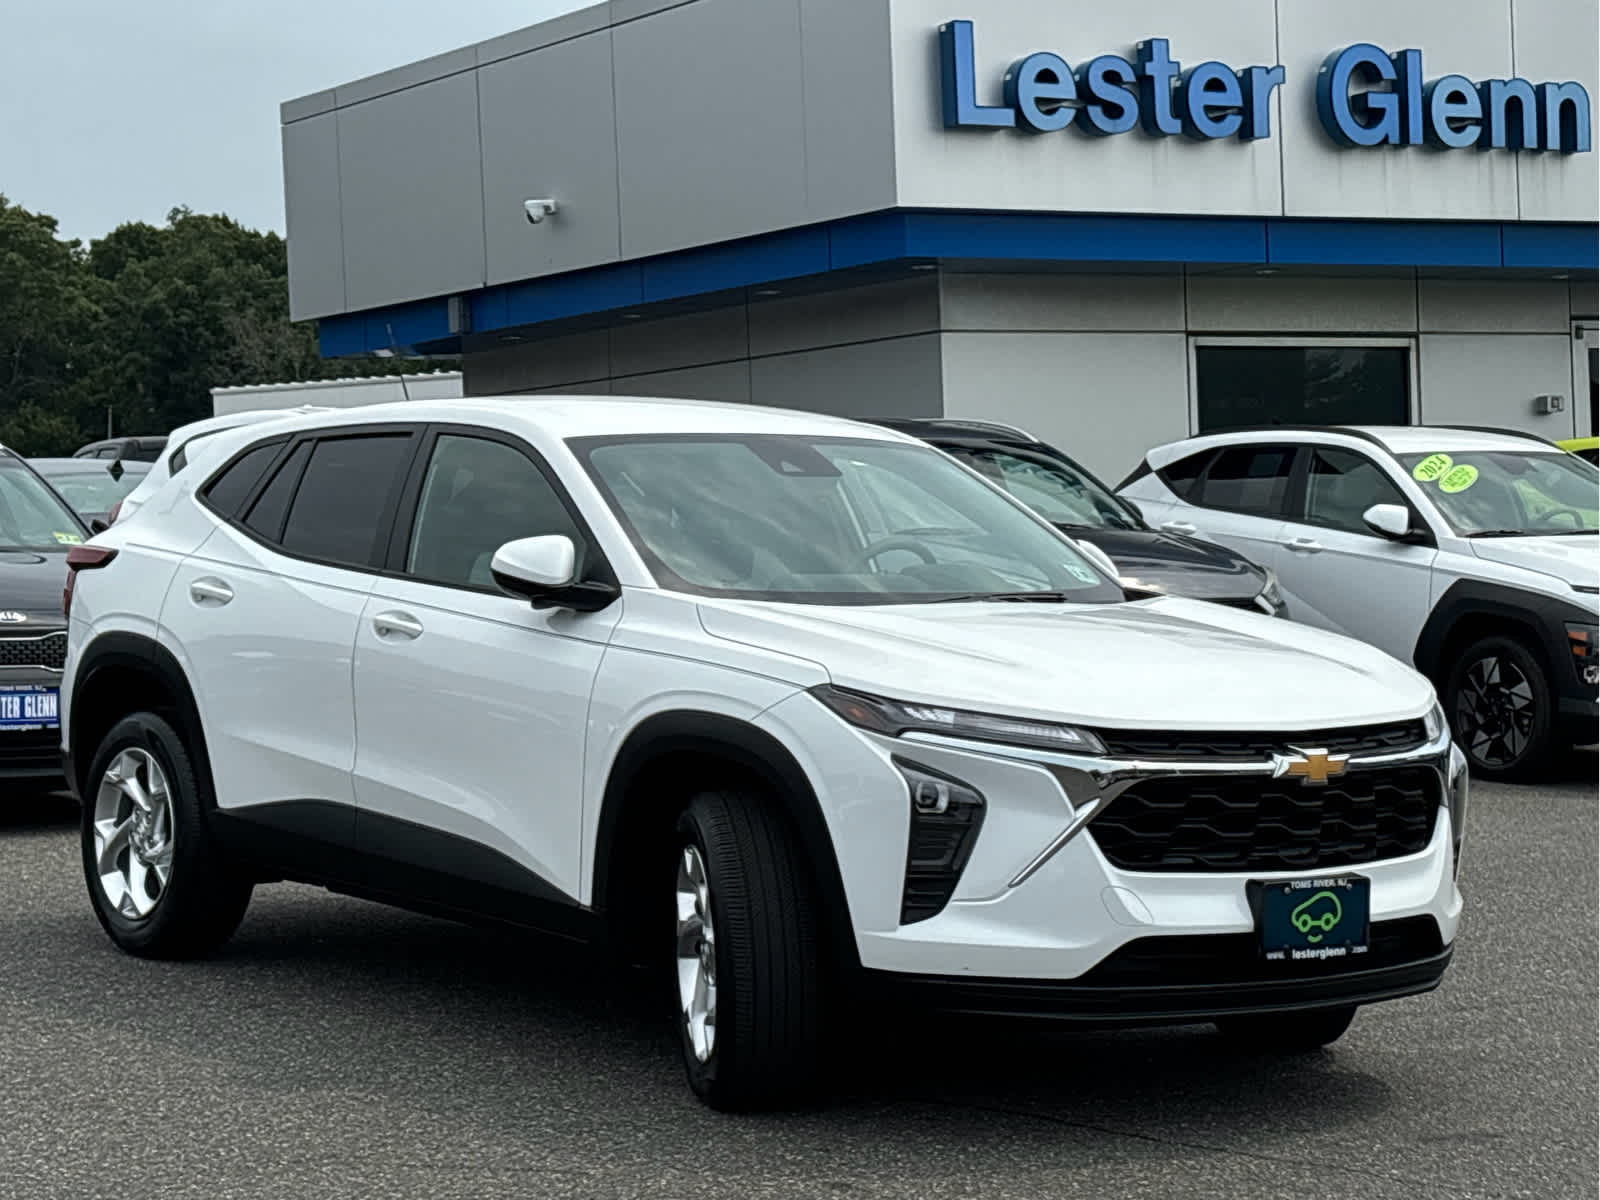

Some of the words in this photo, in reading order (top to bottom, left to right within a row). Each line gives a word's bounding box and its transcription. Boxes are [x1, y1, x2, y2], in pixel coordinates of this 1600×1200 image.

[939, 20, 1285, 140] Lester
[1317, 43, 1591, 153] Glenn
[1419, 456, 1447, 478] 2024
[24, 695, 57, 718] GLENN
[1291, 880, 1311, 888] TOMS
[1292, 946, 1346, 960] lesterglenn
